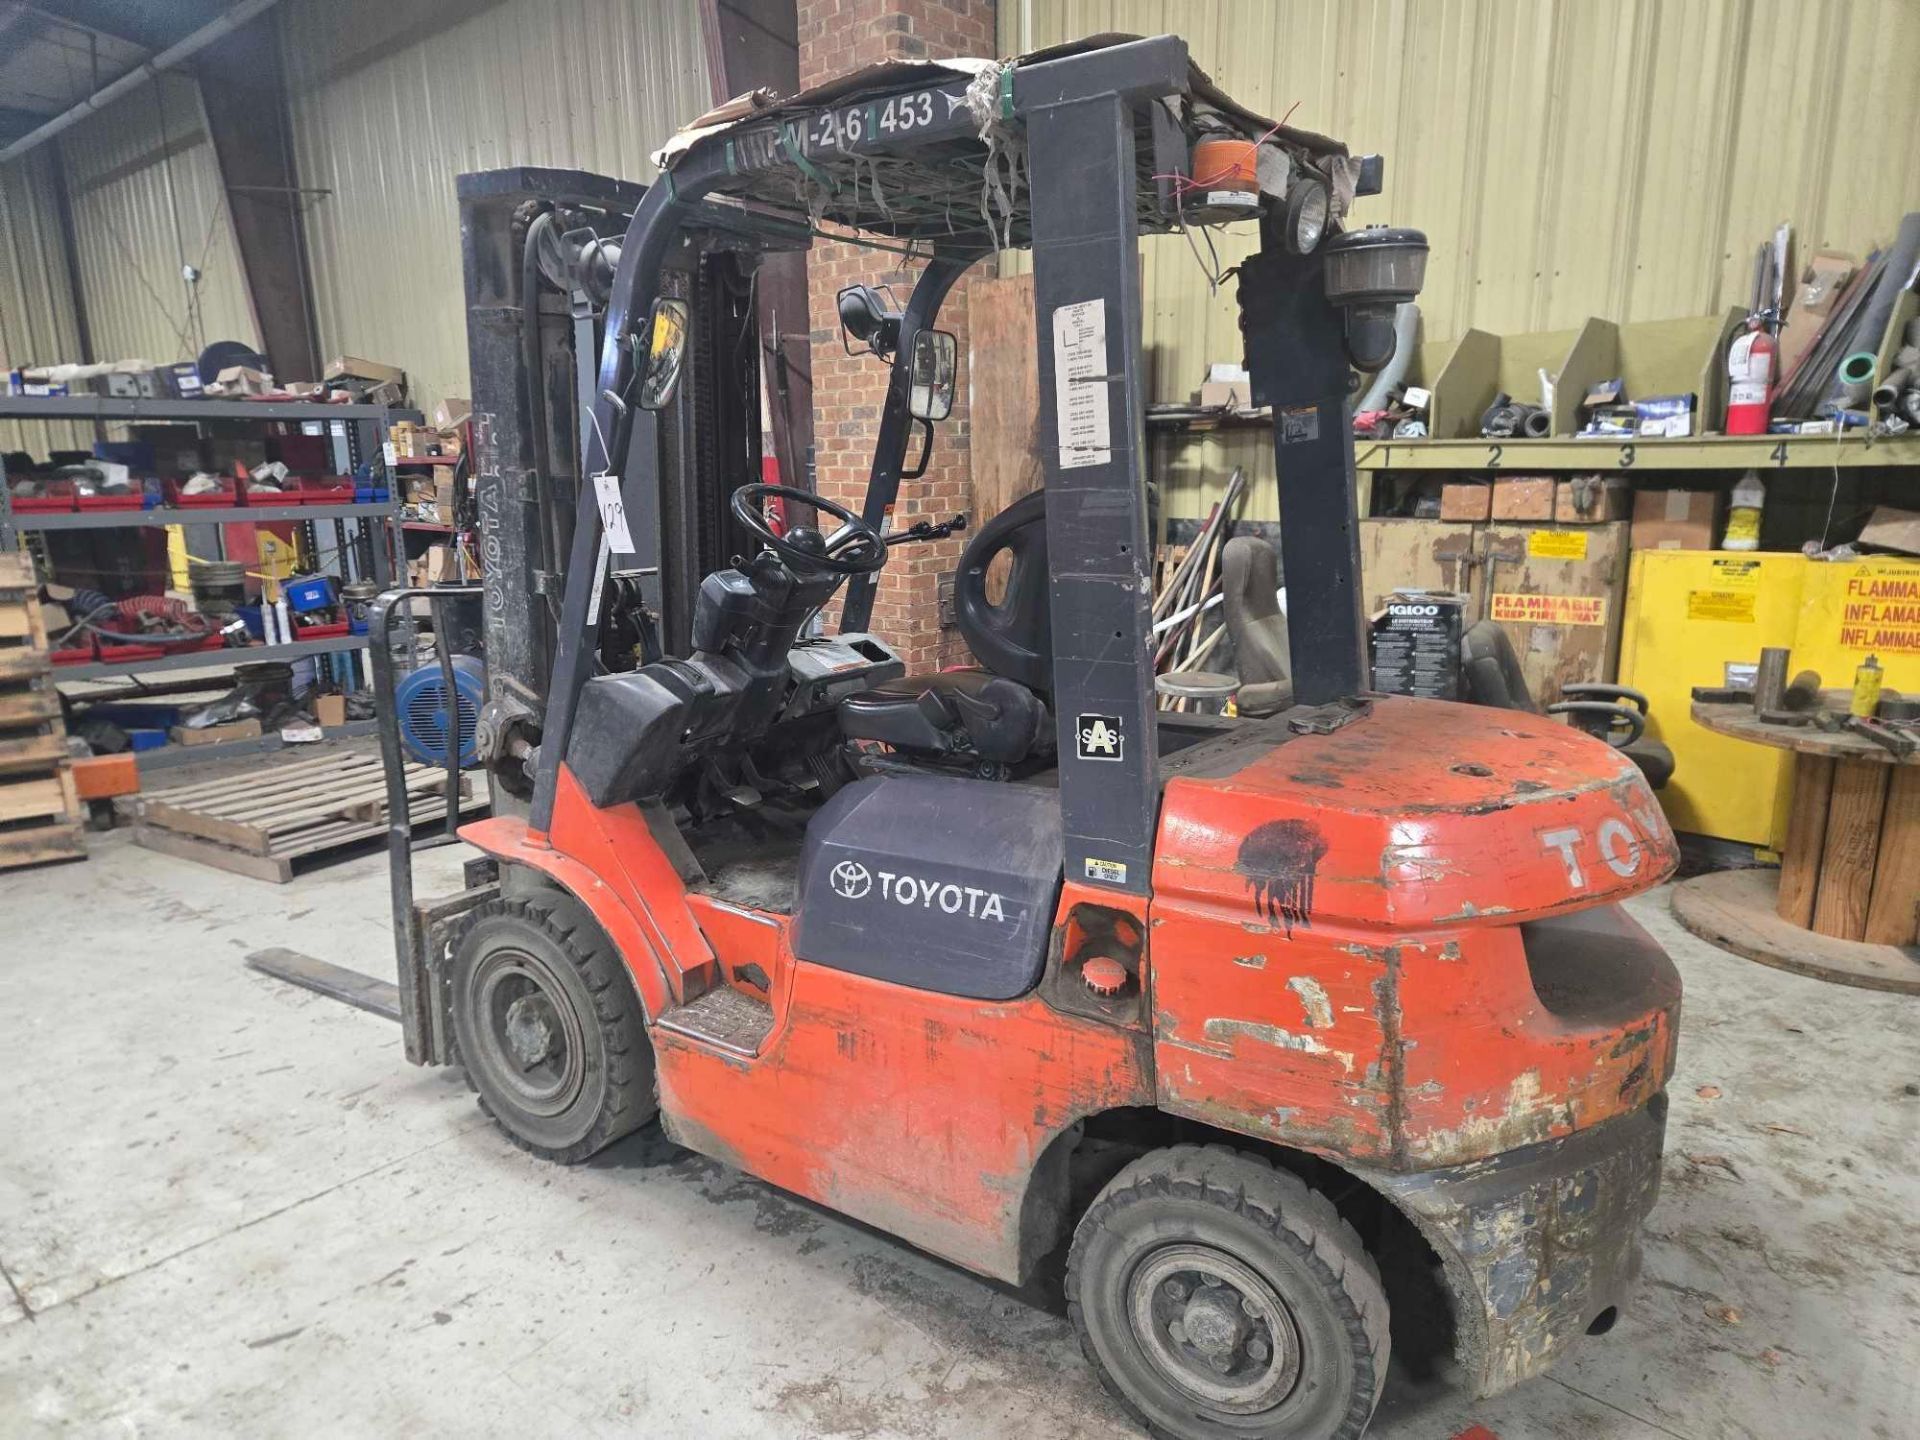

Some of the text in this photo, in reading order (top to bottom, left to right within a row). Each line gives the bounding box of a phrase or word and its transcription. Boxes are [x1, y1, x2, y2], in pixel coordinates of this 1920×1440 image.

[1383, 445, 1390, 468] 1
[1487, 446, 1502, 468] 2
[1619, 443, 1636, 468] 3
[1769, 441, 1789, 467] 4
[1848, 579, 1920, 599] FLAMMA
[1389, 605, 1439, 616] IGLOO
[1494, 596, 1603, 612] FLAMMABLE
[1494, 609, 1600, 622] KEEP FIRE WAY
[878, 872, 1005, 923] TOYOTA
